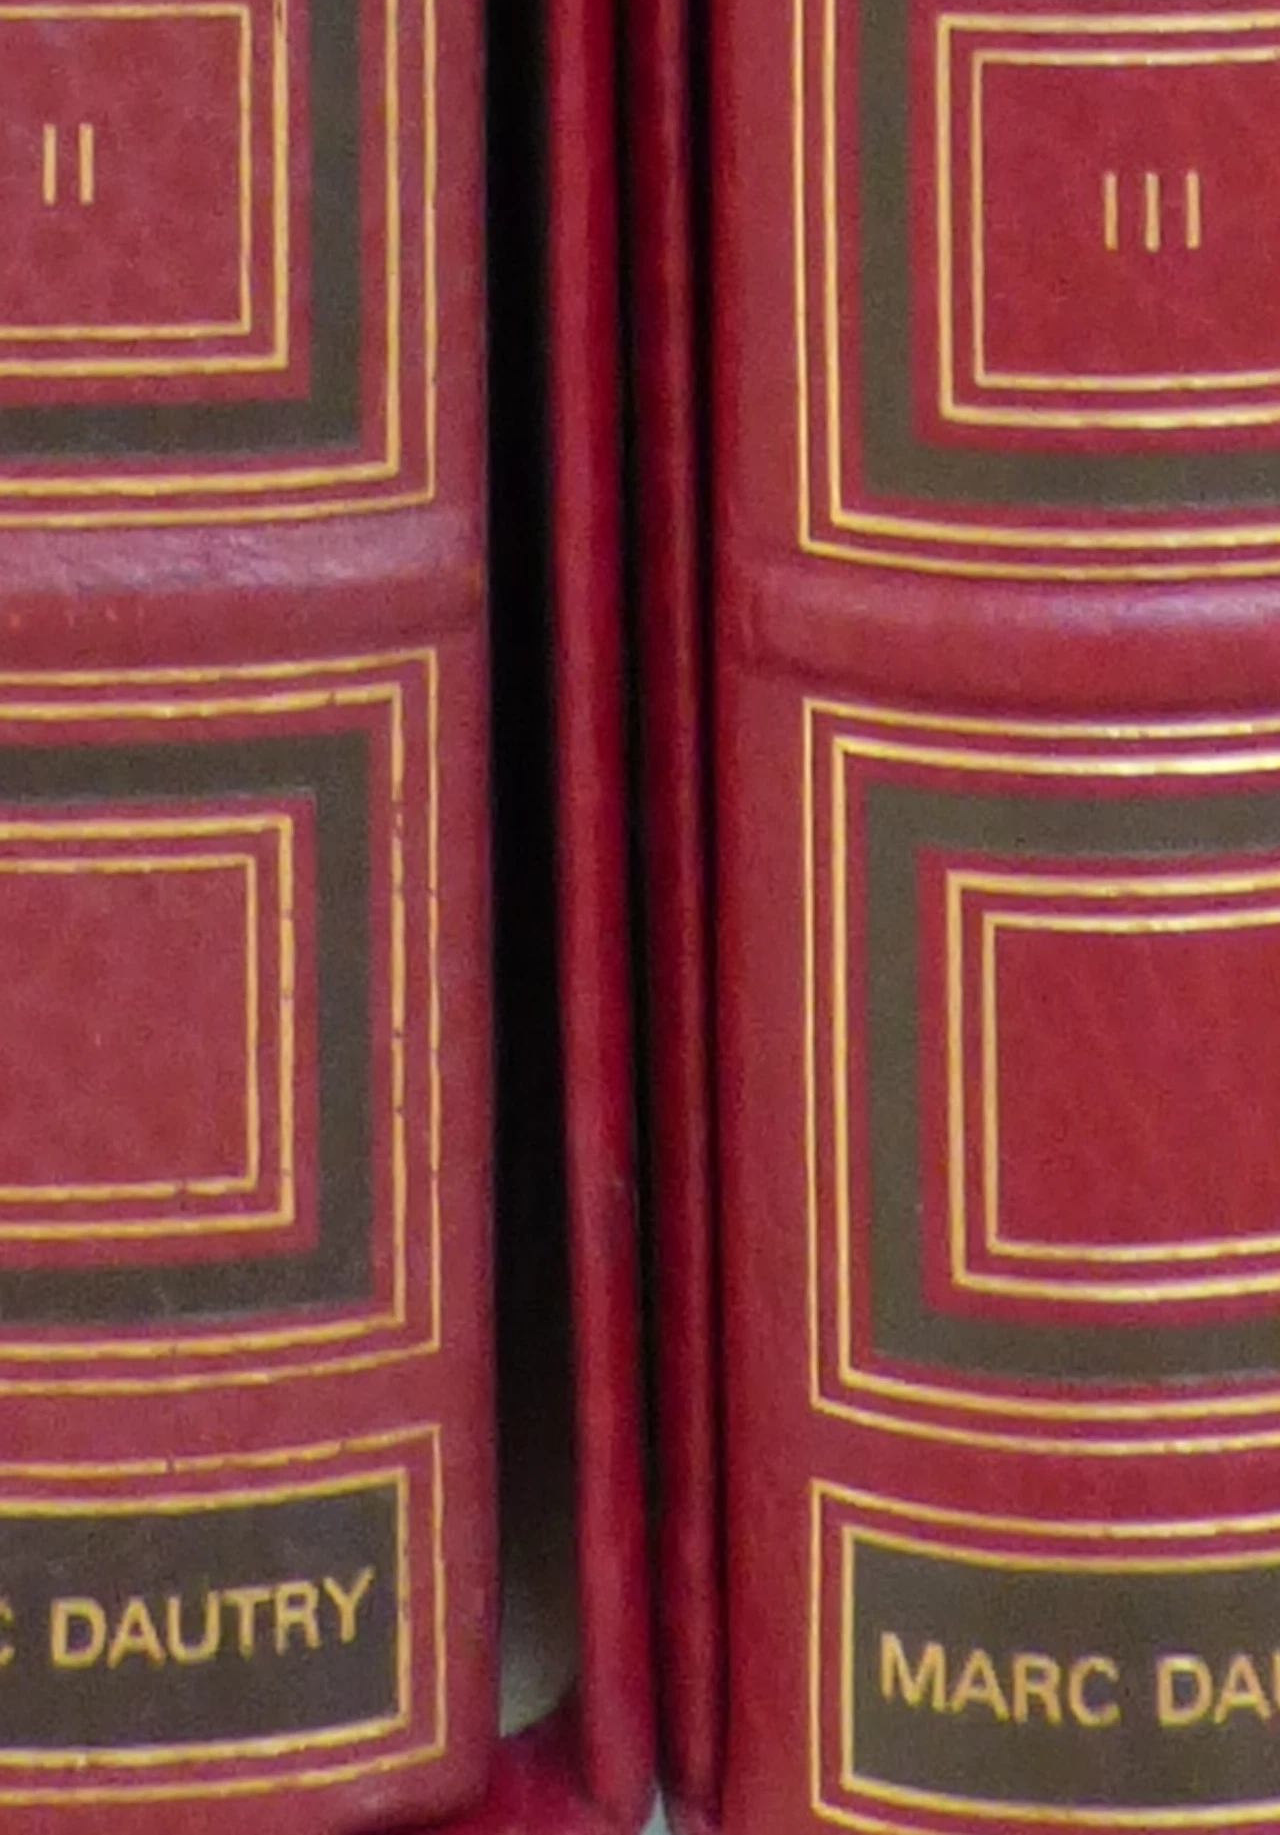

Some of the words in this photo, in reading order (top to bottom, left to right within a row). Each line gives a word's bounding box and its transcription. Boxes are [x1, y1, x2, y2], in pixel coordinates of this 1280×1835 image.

[41, 122, 95, 206] II
[1102, 168, 1202, 253] III
[49, 1566, 375, 1669] DAUTRY
[879, 1630, 1121, 1728] MARC
